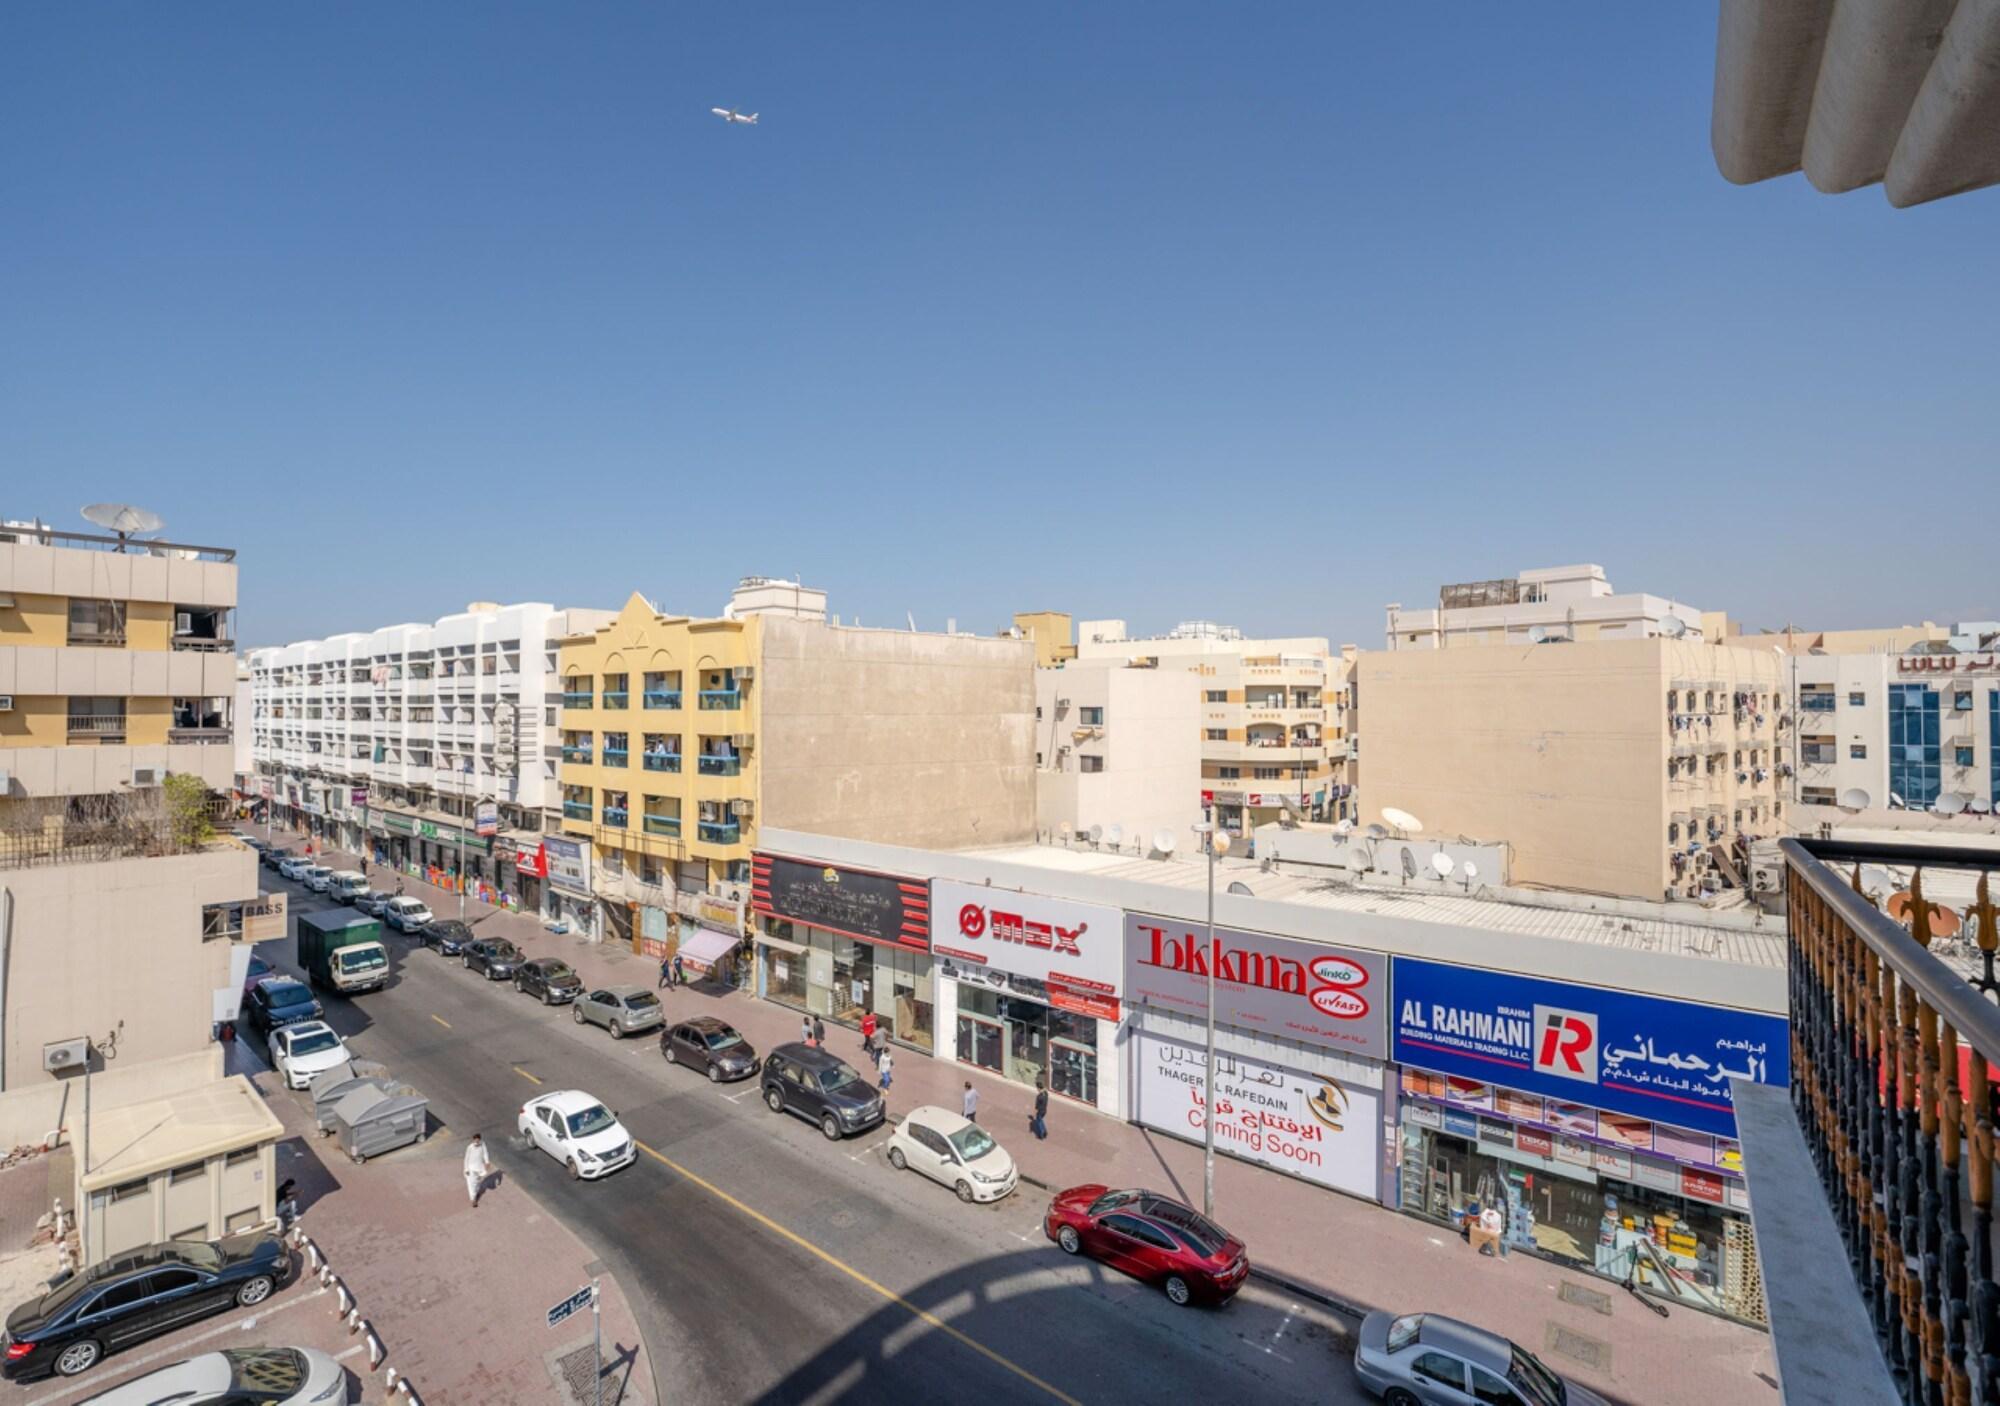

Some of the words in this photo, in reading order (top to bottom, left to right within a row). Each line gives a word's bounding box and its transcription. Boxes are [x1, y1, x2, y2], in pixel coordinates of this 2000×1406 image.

[1898, 655, 1957, 673] LULU
[245, 902, 283, 918] BASS
[1400, 999, 1427, 1029] AL
[1432, 1004, 1531, 1049] RAHMANI
[1497, 1005, 1531, 1019] IBRAHIM
[1400, 1026, 1434, 1041] BUILDING
[1434, 1033, 1474, 1049] MATERIALS
[1474, 1042, 1508, 1057] TRADING
[1158, 1065, 1204, 1087] THAGER
[1225, 1084, 1288, 1111] RAFEDAIN
[1267, 1133, 1321, 1167] Soon
